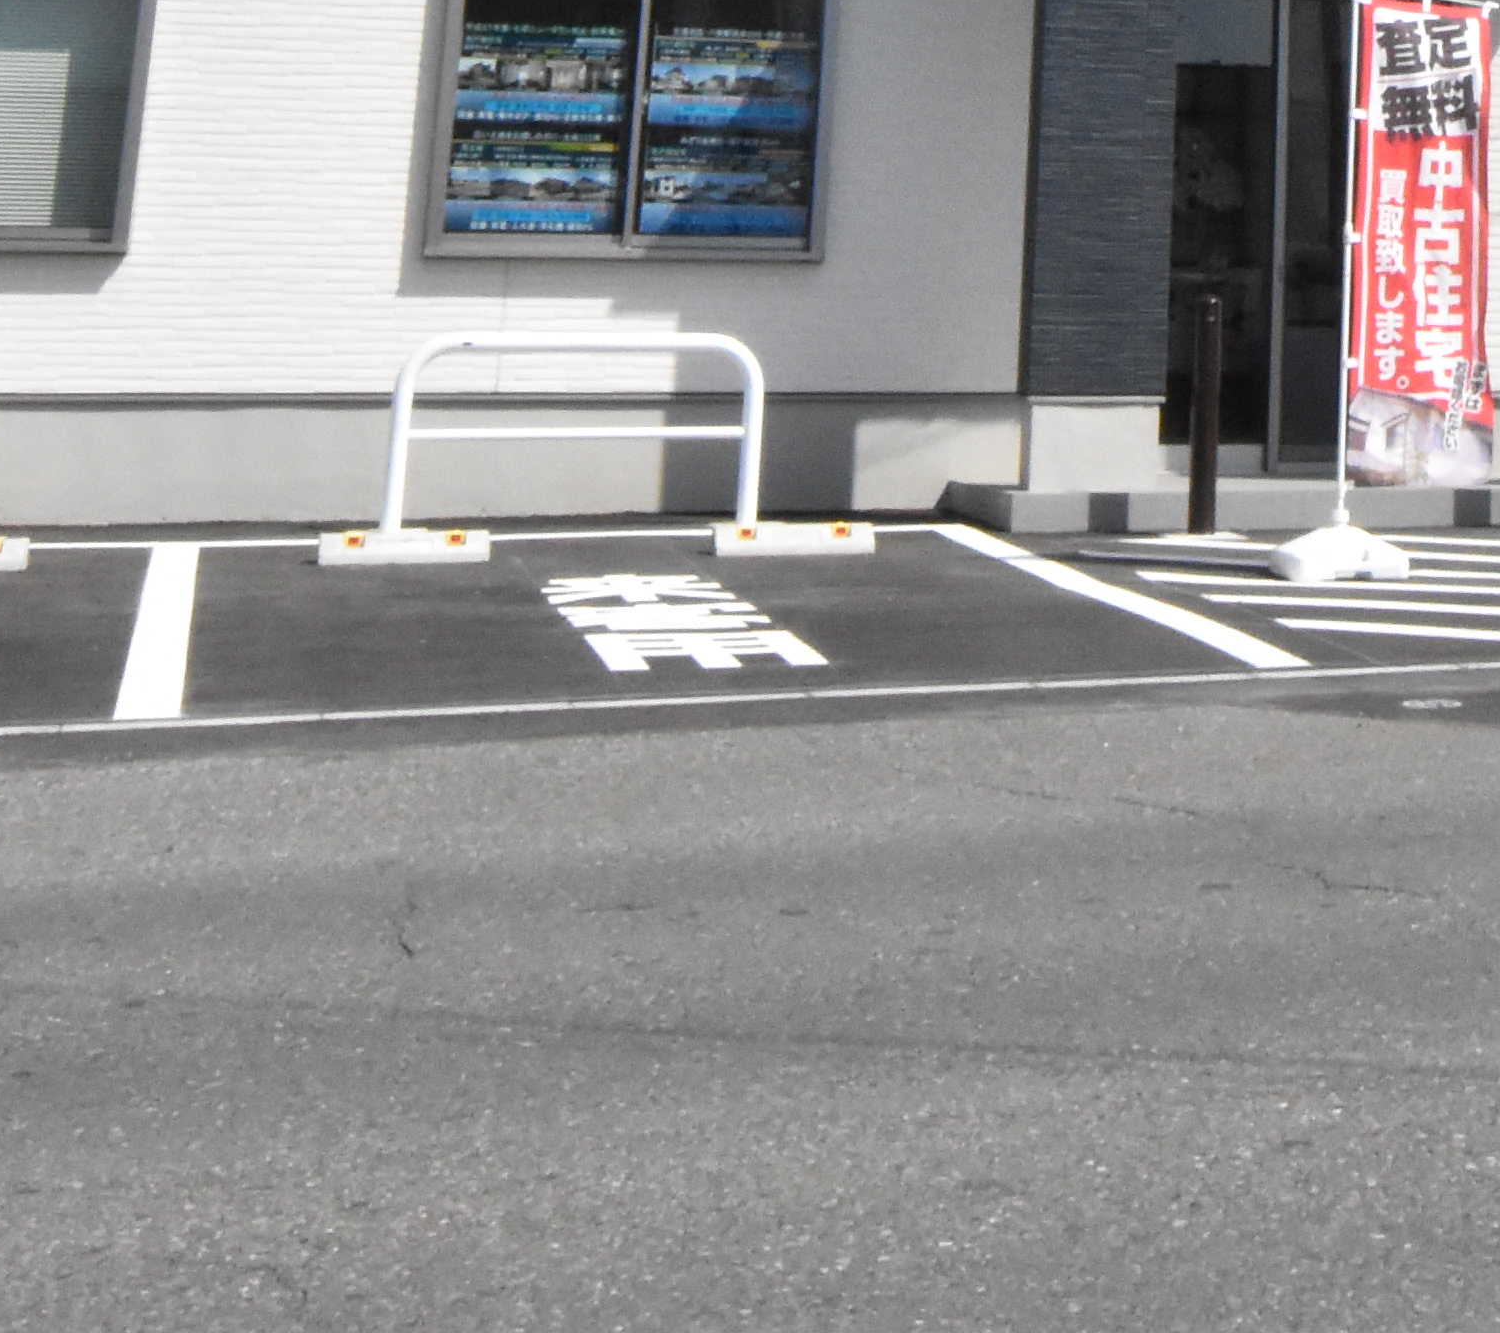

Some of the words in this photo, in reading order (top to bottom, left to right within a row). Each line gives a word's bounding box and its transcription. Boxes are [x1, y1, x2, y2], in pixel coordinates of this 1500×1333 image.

[1373, 169, 1409, 389] 買取致します。
[1413, 141, 1465, 391] 中古住宅
